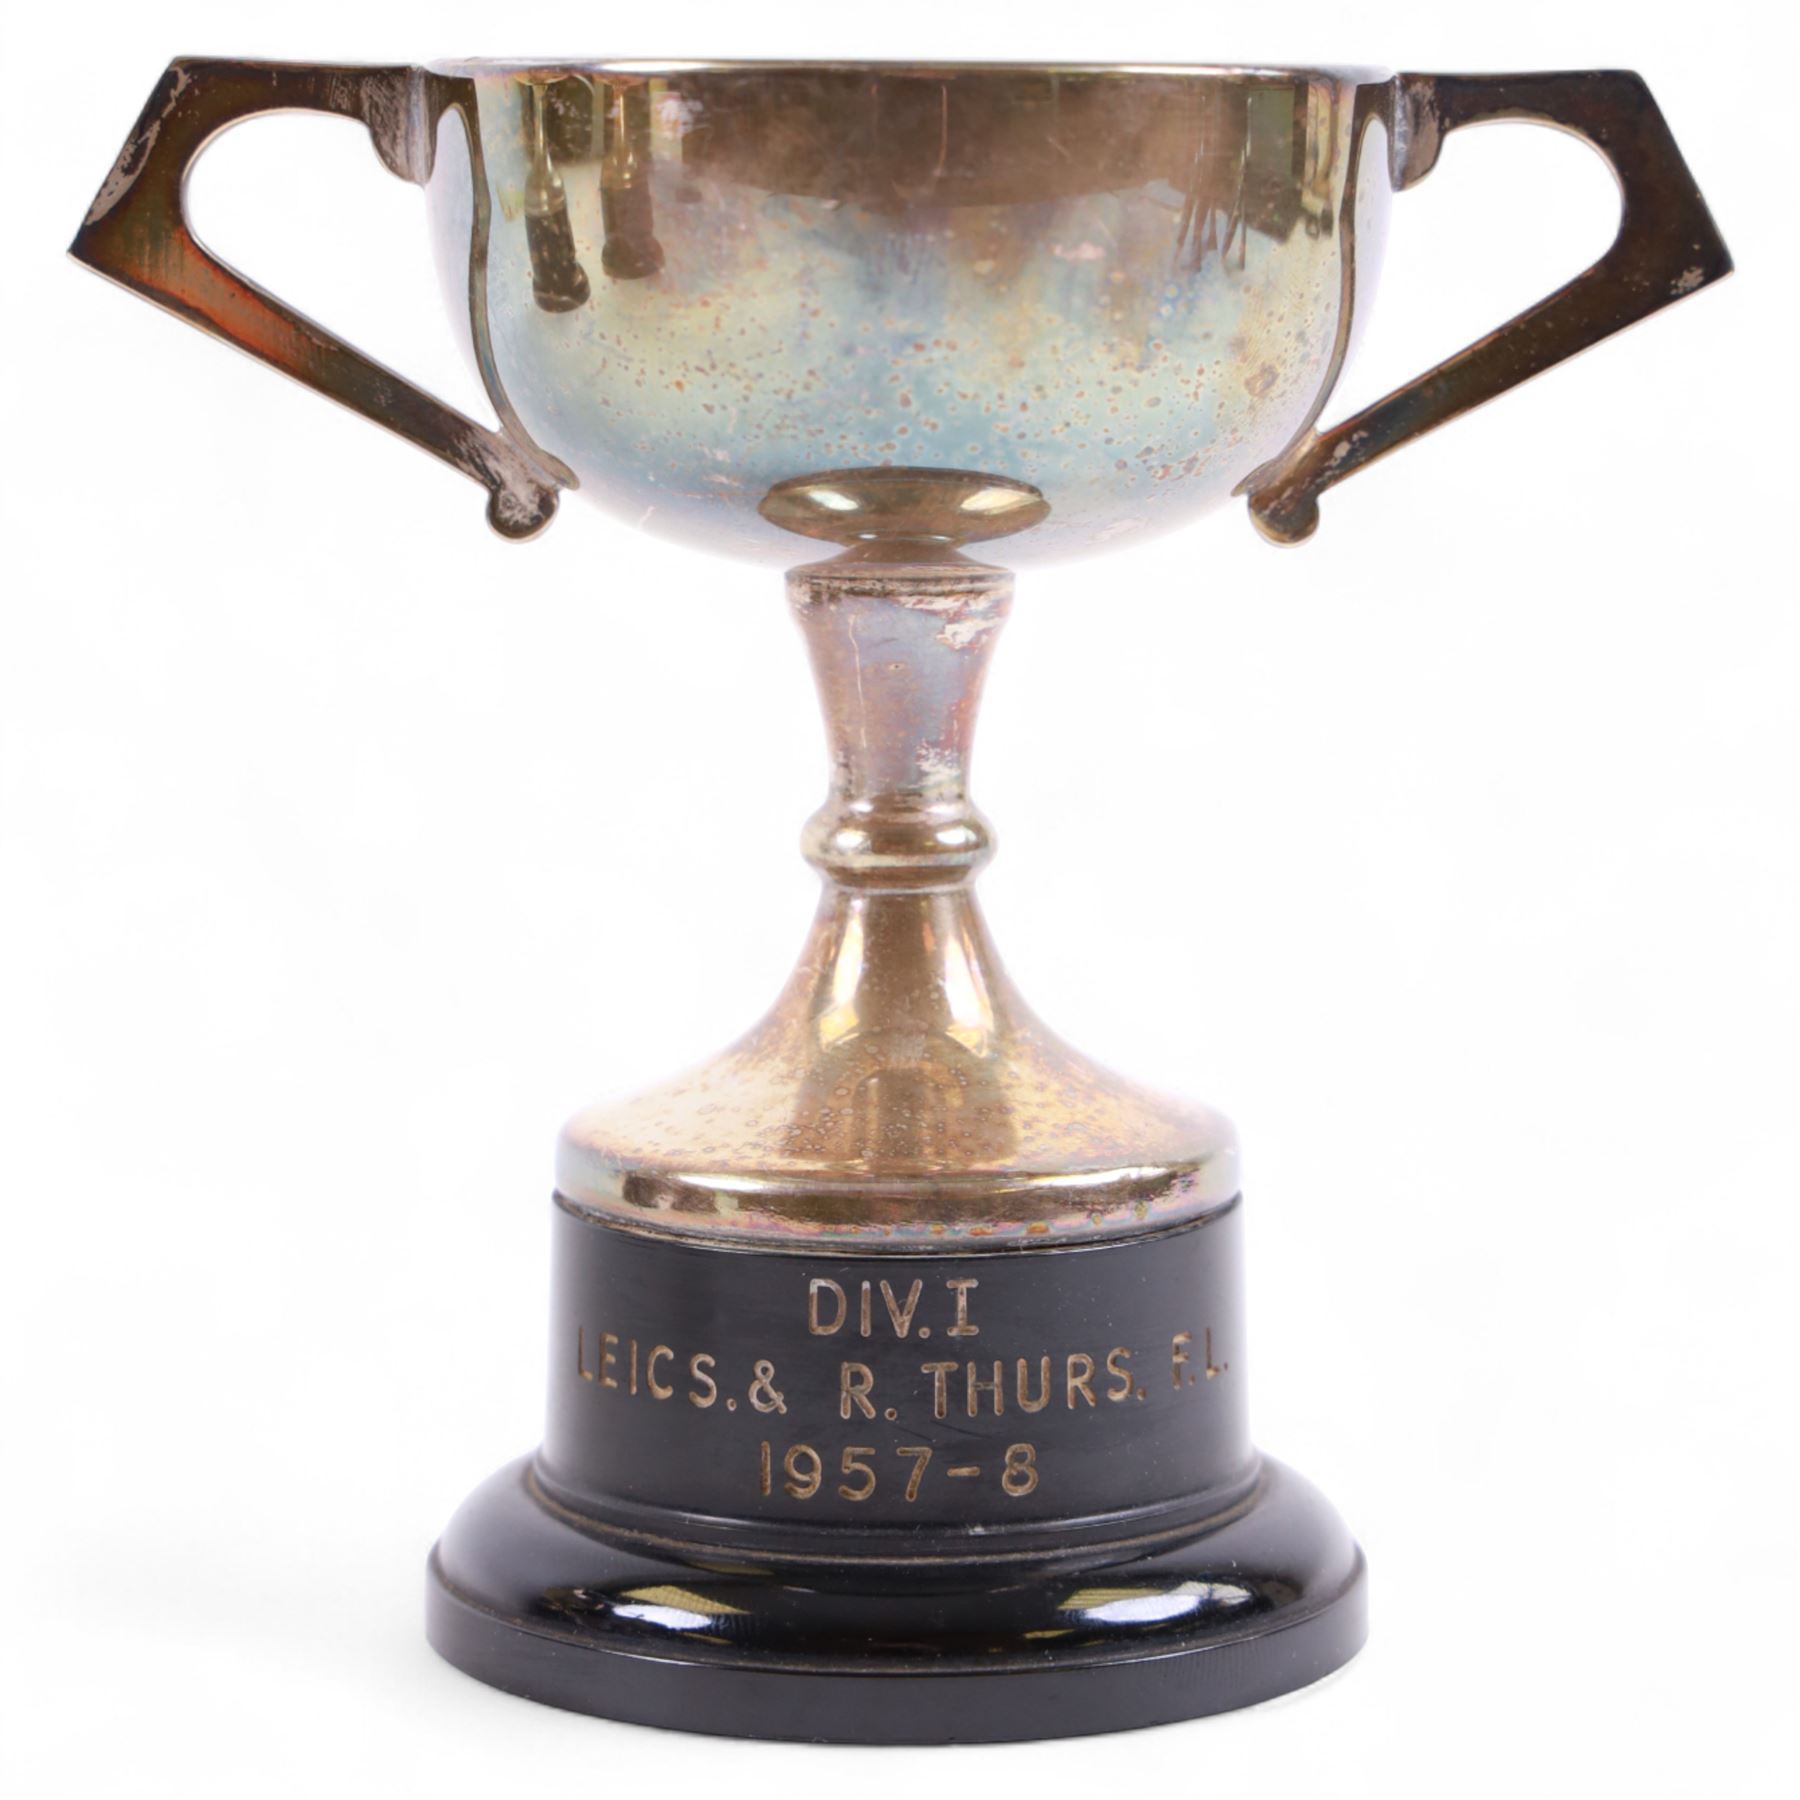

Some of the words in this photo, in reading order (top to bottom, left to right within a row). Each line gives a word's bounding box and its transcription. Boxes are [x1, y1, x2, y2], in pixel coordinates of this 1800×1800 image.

[839, 1361, 897, 1420] R.
[920, 1346, 1147, 1419] THURS.
[760, 1440, 1039, 1502] 1957-8
